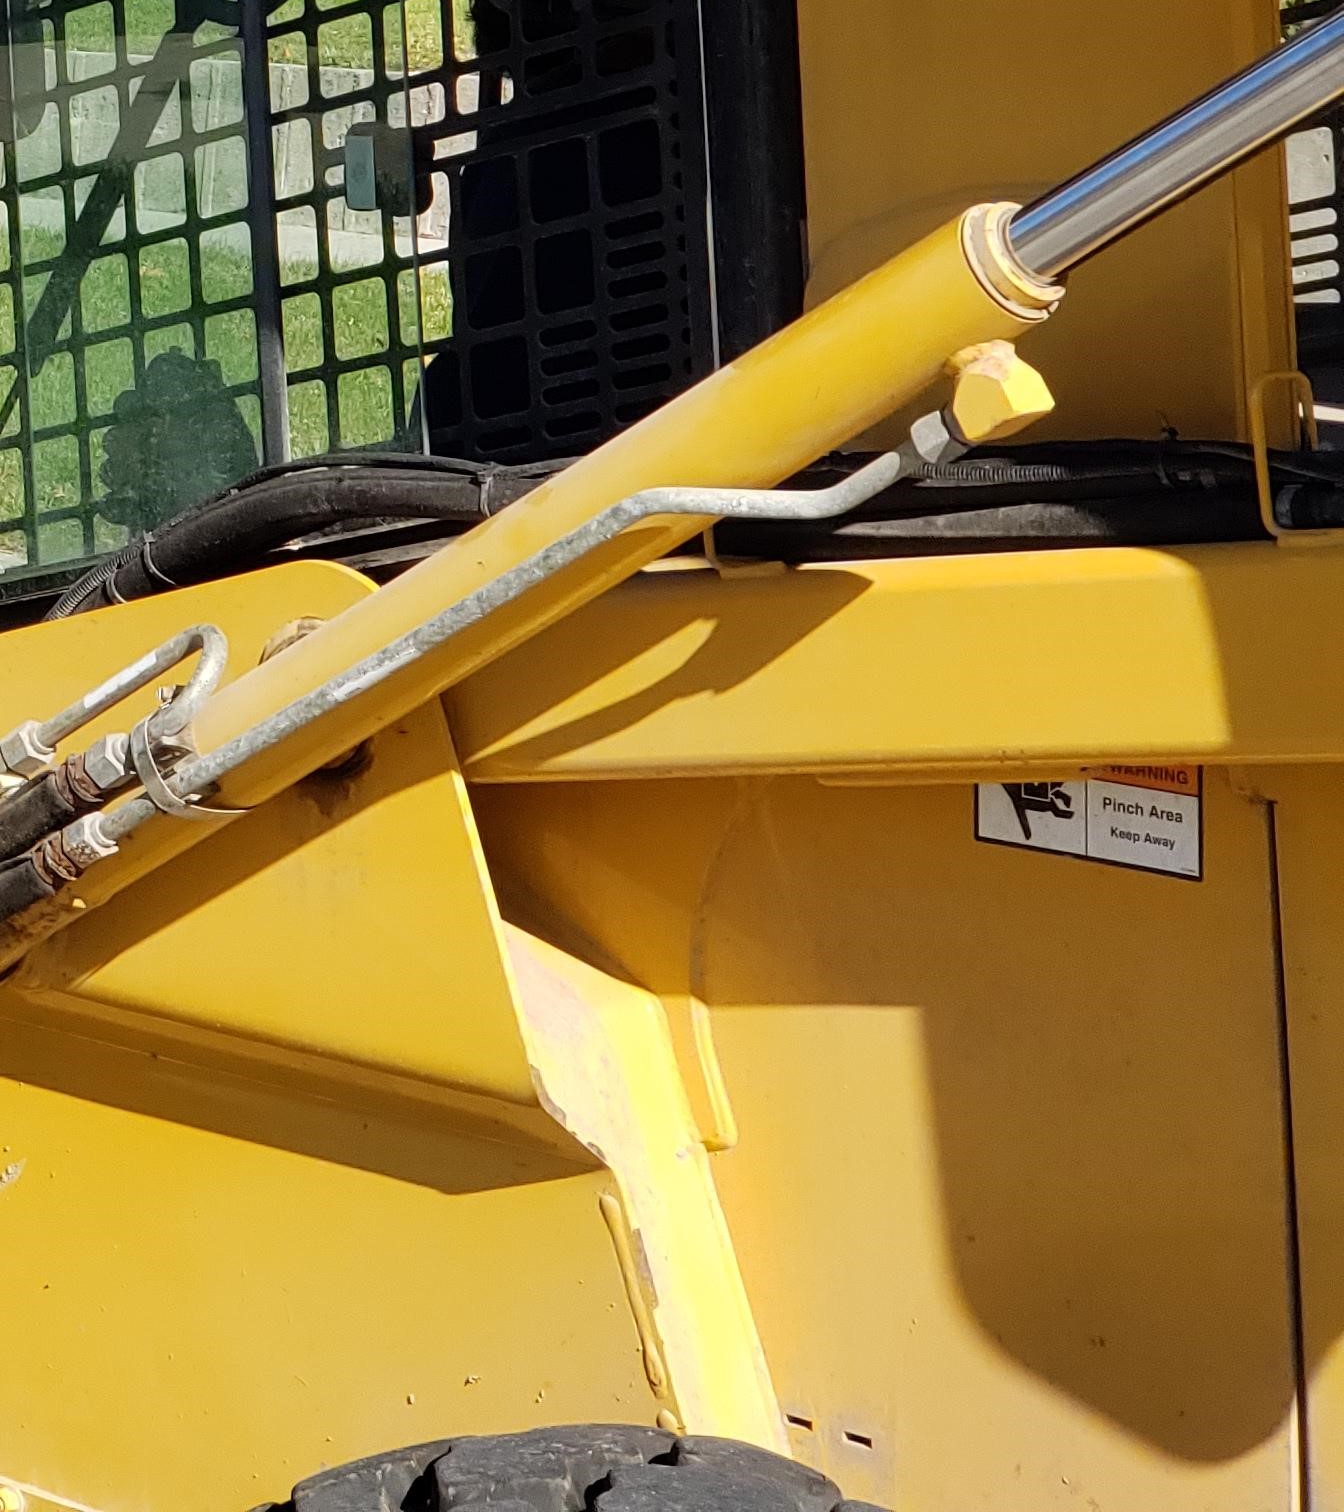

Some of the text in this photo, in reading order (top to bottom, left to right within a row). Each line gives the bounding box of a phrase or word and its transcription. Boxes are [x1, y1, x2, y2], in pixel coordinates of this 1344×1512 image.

[1102, 797, 1184, 823] Pinch Area
[1110, 826, 1176, 851] Keep Away
